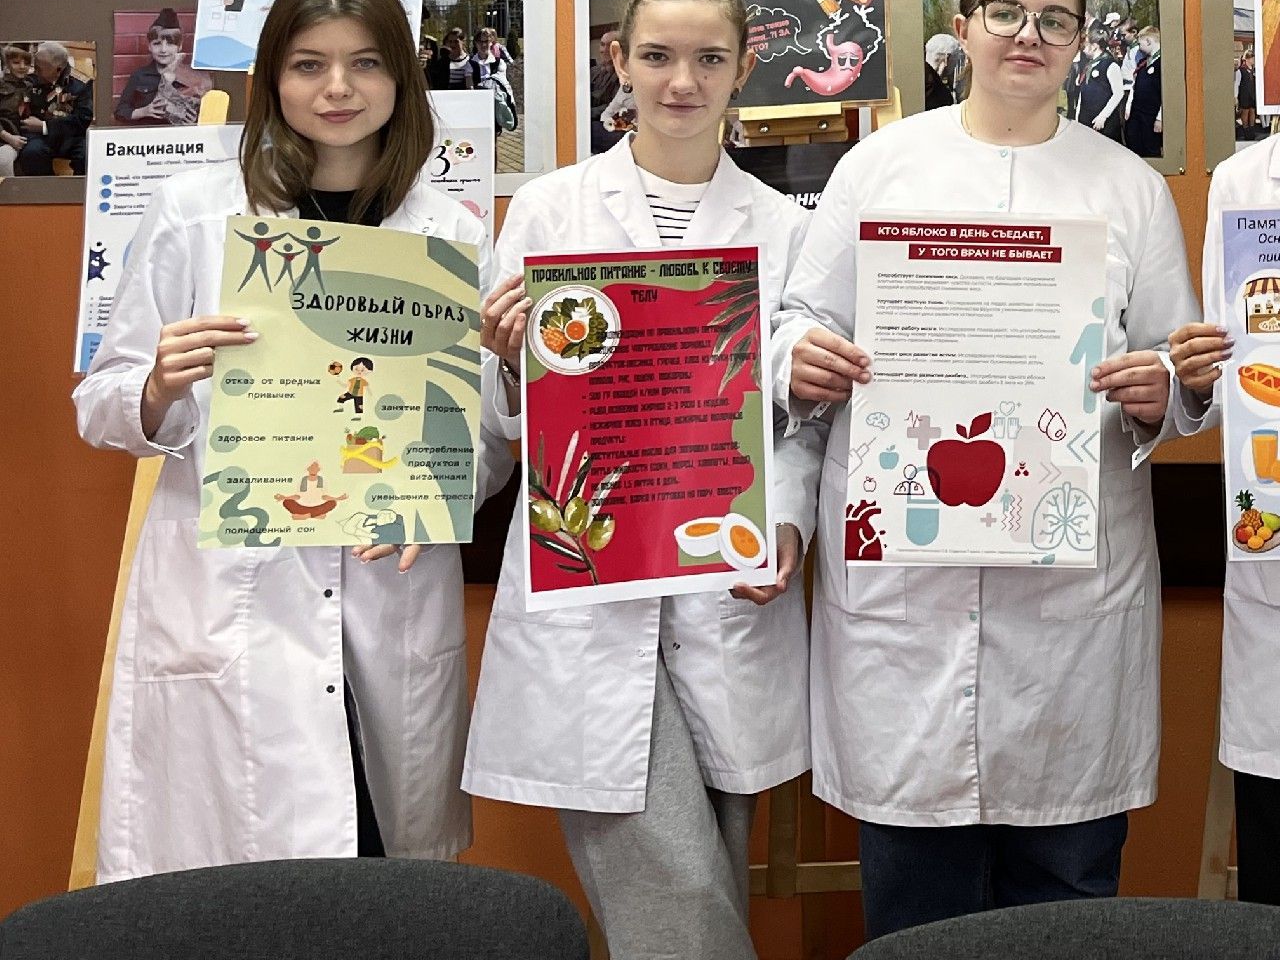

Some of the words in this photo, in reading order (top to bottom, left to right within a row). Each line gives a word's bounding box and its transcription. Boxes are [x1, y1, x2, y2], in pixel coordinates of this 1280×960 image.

[106, 142, 204, 157] Вакцинация
[877, 226, 900, 236] КТО
[901, 227, 947, 237] ЯБЛОКО
[950, 228, 957, 237] В
[959, 228, 989, 239] ДЕНЬ
[991, 229, 1044, 241] СЪЕДАЕТ,
[918, 247, 926, 256] У
[930, 247, 958, 257] ТОГО
[960, 248, 990, 258] ВРАЧ
[992, 249, 1006, 258] НЕ
[1009, 250, 1053, 260] БЫВАЕТ
[531, 266, 597, 283] ПРАВИЛЬНОЕ
[600, 264, 647, 280] ПИТАНИЕ
[658, 262, 699, 278] ЛЮБОВЬ
[702, 261, 710, 275] К
[713, 259, 752, 275] СВОЕМУ
[631, 288, 658, 304] ТЕЛУ
[346, 327, 413, 346] ЖИЗНИ
[280, 378, 321, 387] вредных
[247, 392, 296, 400] привычек
[217, 435, 266, 444] здоровое
[406, 445, 474, 455] употребление
[408, 460, 460, 468] продуктов
[371, 493, 429, 502] уменьшение
[434, 493, 474, 501] стресса
[225, 526, 291, 535] полноценный
